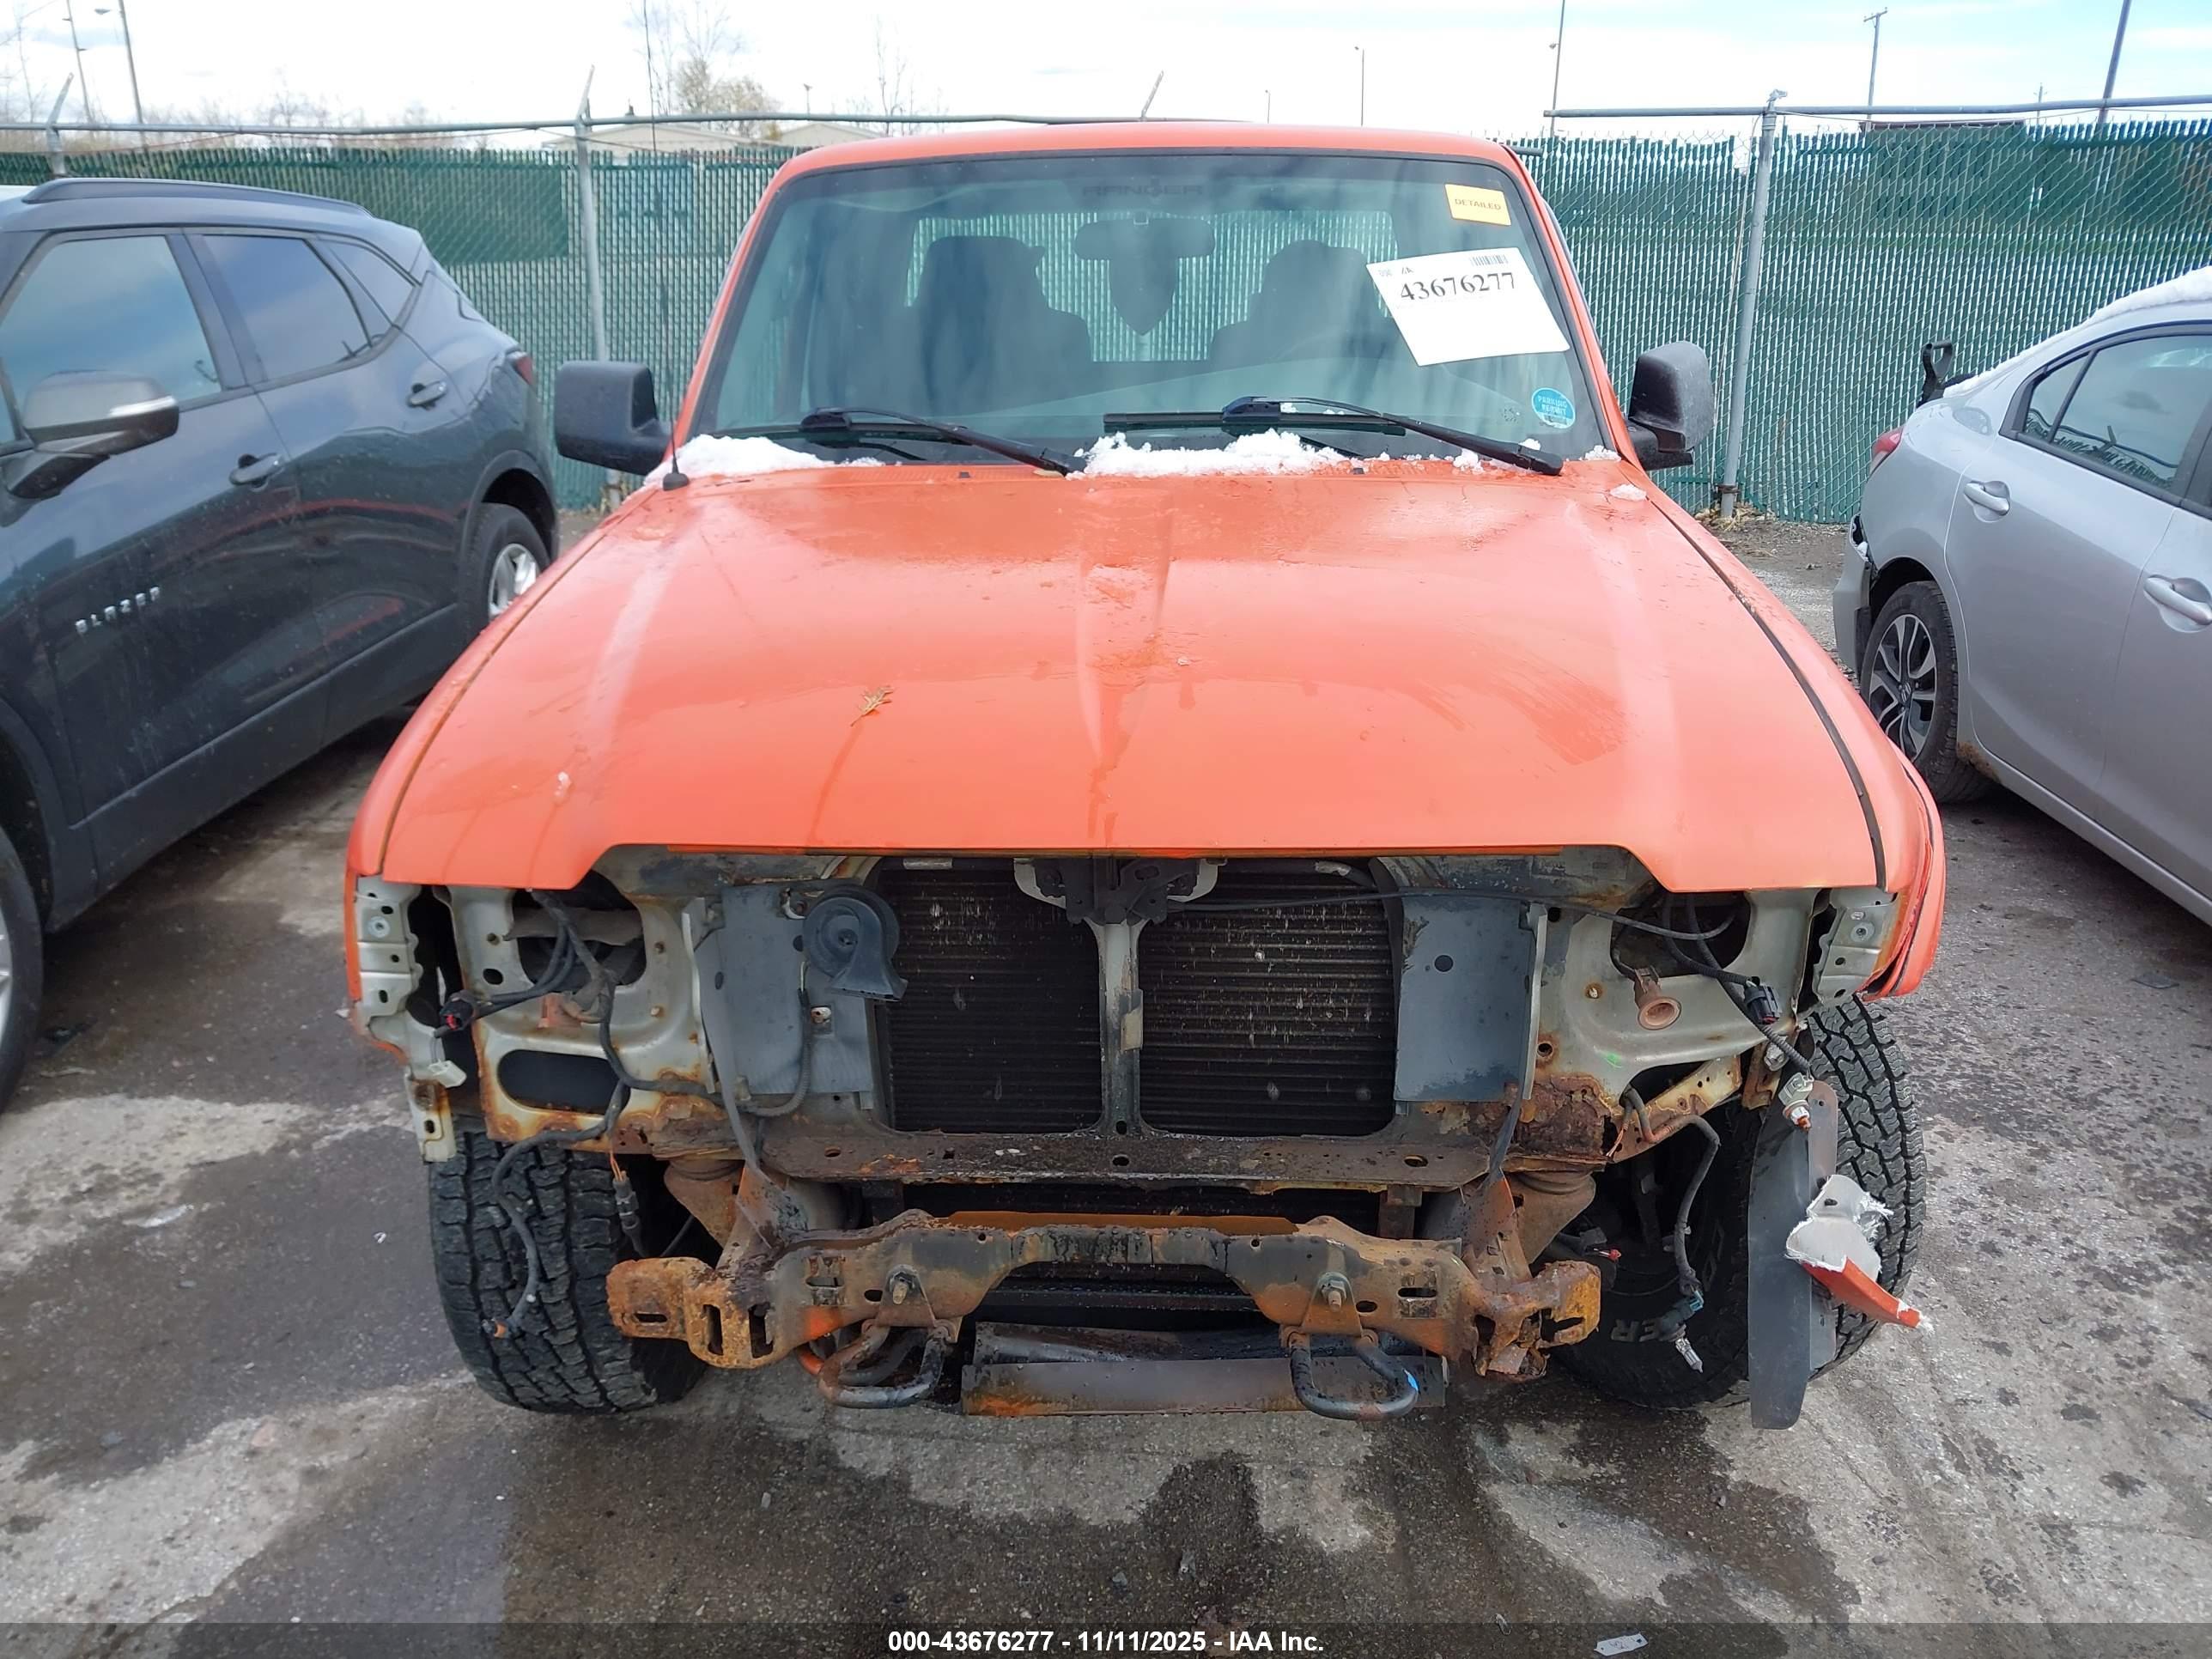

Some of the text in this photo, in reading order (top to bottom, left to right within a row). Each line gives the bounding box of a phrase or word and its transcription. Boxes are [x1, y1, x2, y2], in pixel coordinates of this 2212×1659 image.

[1455, 198, 1502, 210] DETAILED
[1401, 272, 1516, 301] 43676277
[75, 586, 160, 634] BLAZER
